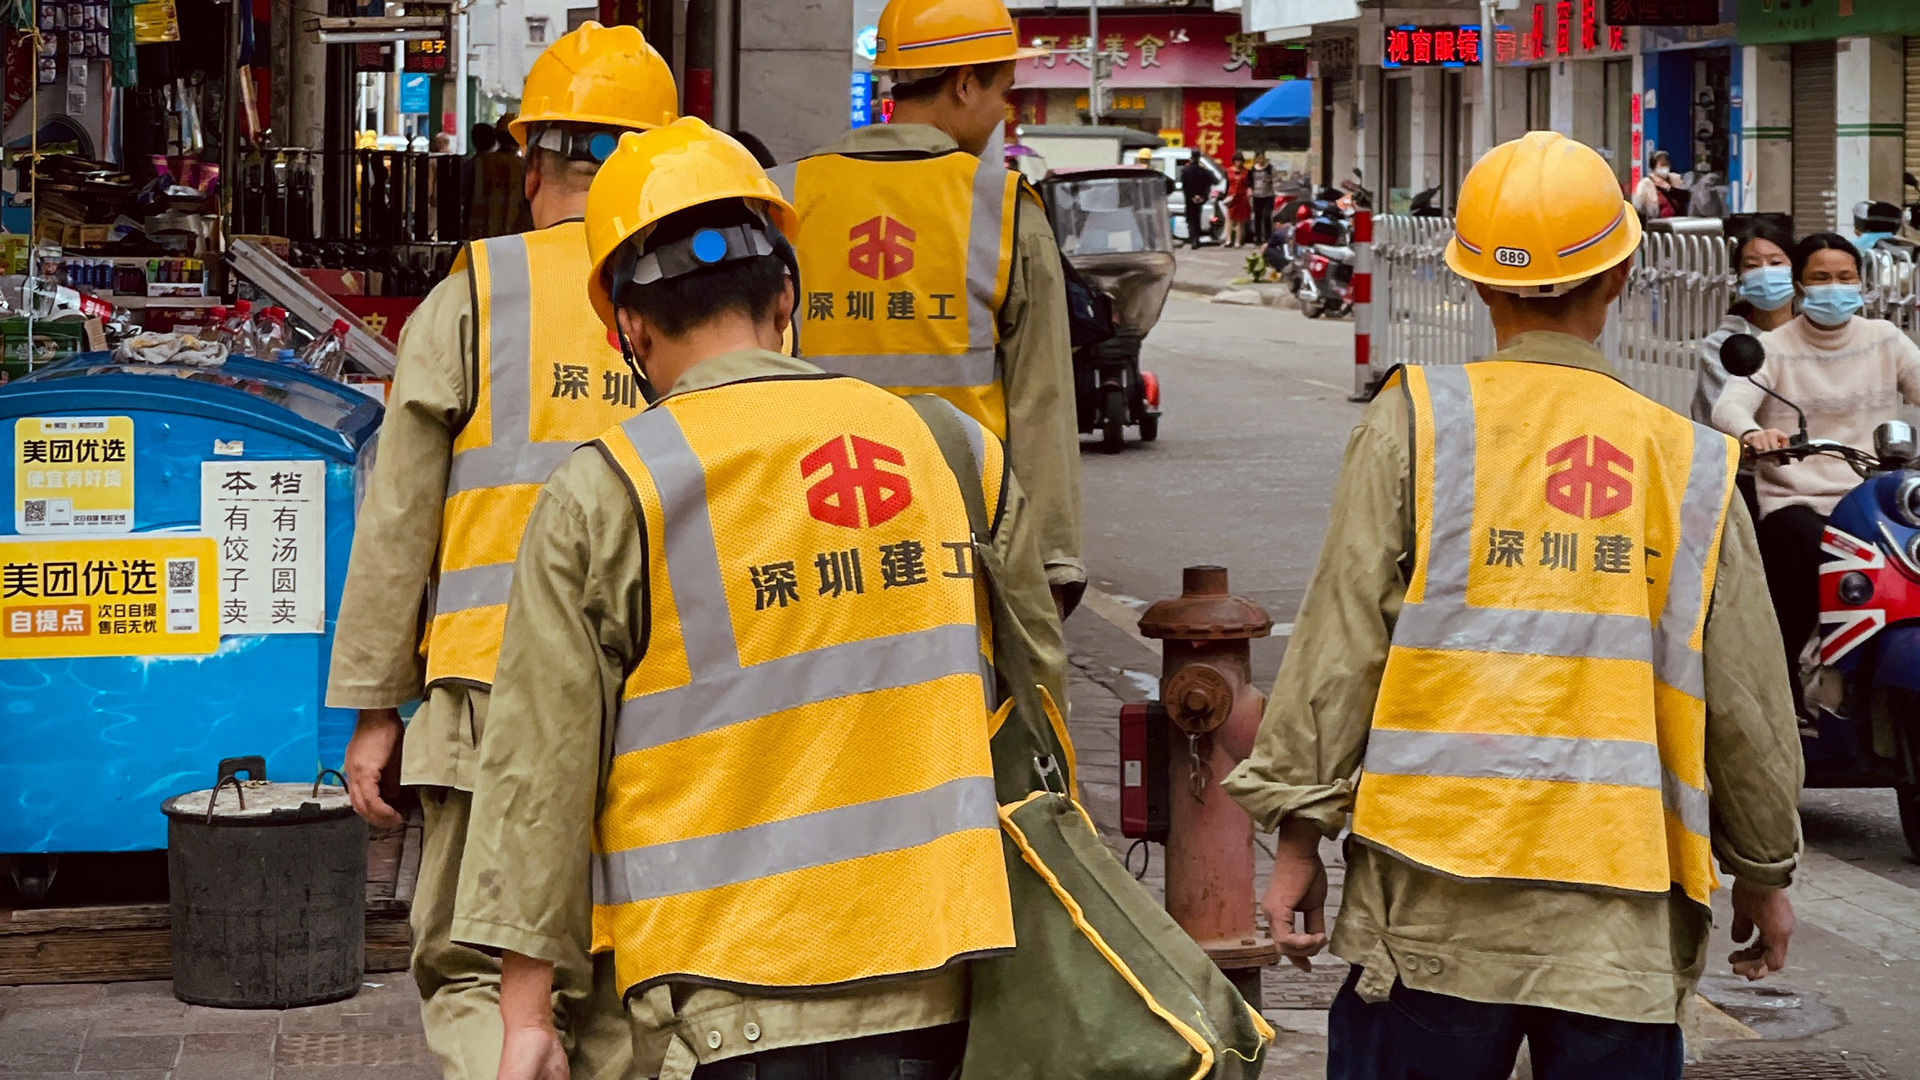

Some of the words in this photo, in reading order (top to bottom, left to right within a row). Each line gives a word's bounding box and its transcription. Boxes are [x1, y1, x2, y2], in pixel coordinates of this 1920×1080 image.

[1387, 29, 1480, 63] 视窗眼镜
[1196, 101, 1224, 164] 煲仔
[1500, 250, 1526, 264] 889
[807, 290, 957, 321] 深圳建工
[551, 362, 637, 408] 深圳
[23, 439, 126, 463] 美团优选
[27, 469, 122, 489] 便宜有好货
[221, 471, 302, 495] 本档
[3, 560, 157, 598] 美团优选
[223, 505, 250, 624] 有饺子卖
[271, 506, 298, 624] 有汤圆卖
[749, 539, 974, 611] 深圳建工
[11, 609, 84, 633] 自提点
[98, 603, 157, 618] 次日自提
[98, 620, 158, 635] 售后无忧
